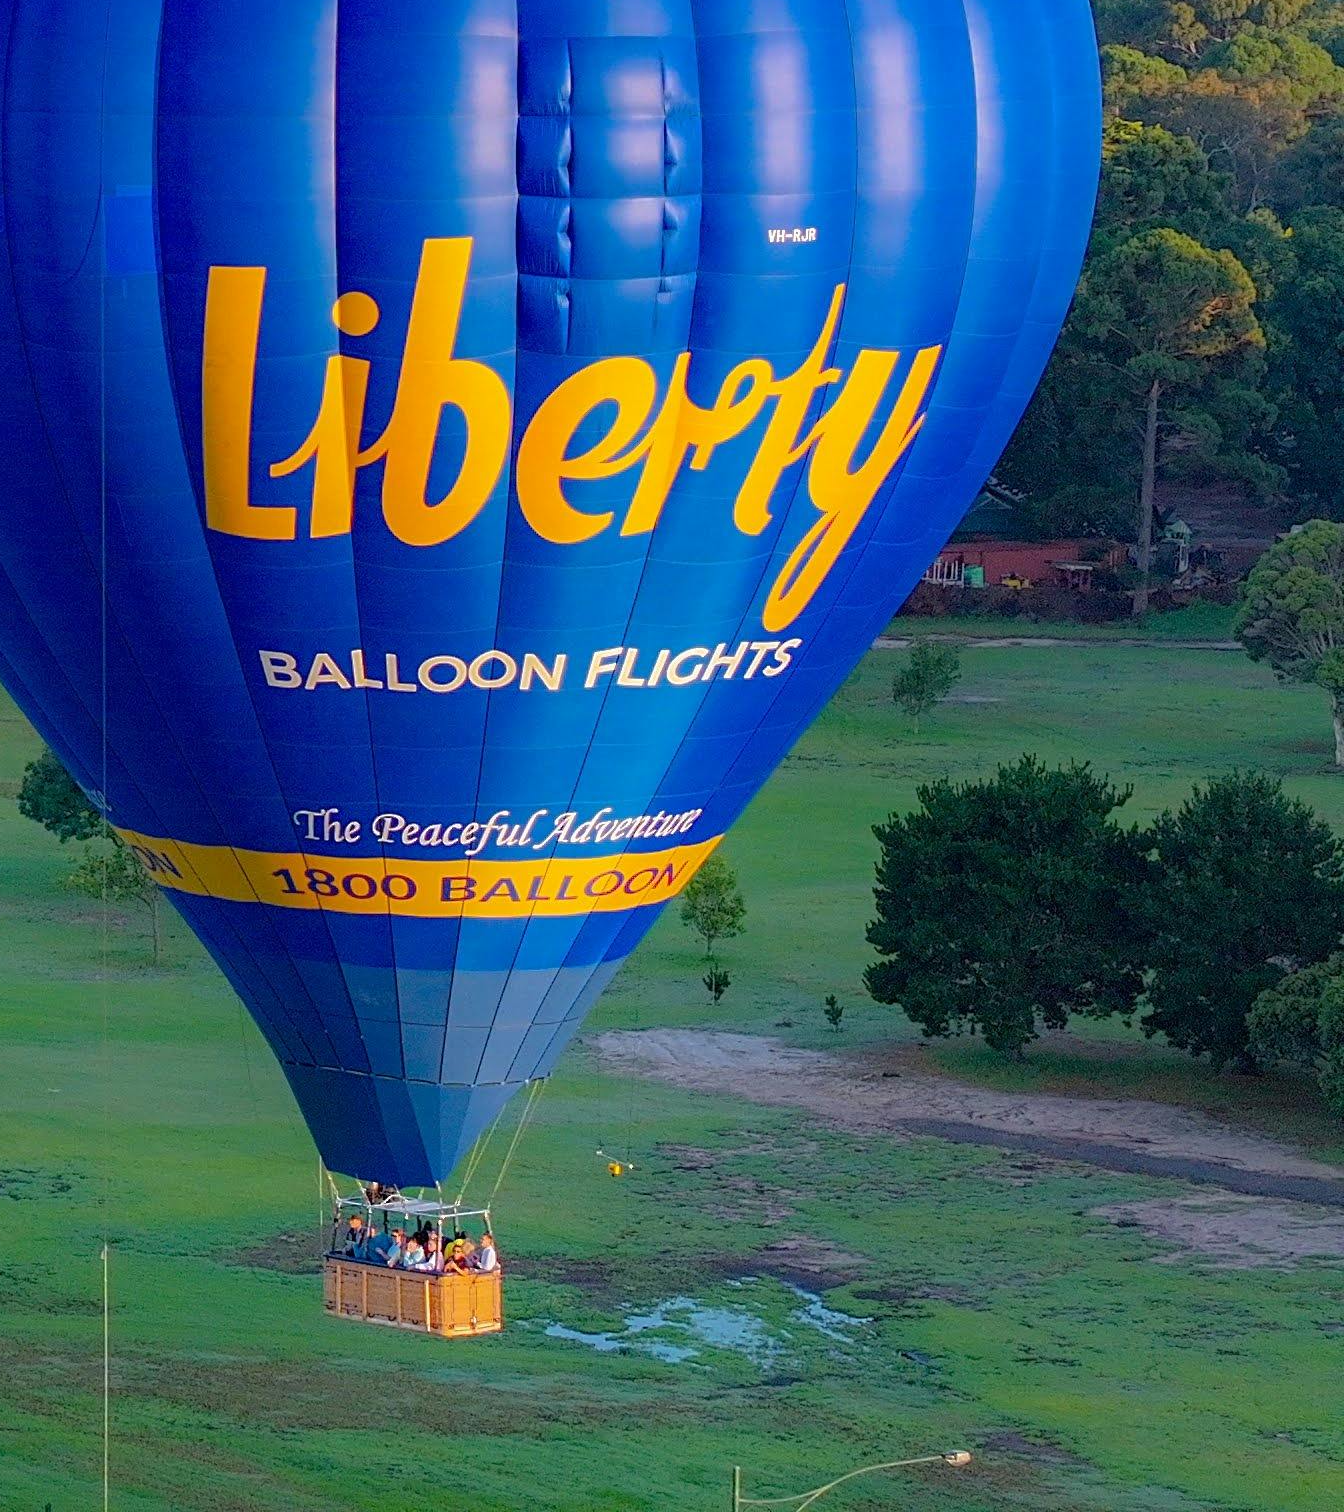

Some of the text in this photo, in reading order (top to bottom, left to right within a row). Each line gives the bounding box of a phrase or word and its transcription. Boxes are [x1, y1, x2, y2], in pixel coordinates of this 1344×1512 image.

[768, 228, 816, 242] VH-RJR
[201, 236, 942, 632] Liberty
[259, 637, 803, 694] BALLOON FLIGHTS
[294, 807, 703, 856] The Peaceful Adventure
[273, 861, 689, 902] 1800 BALLOON
